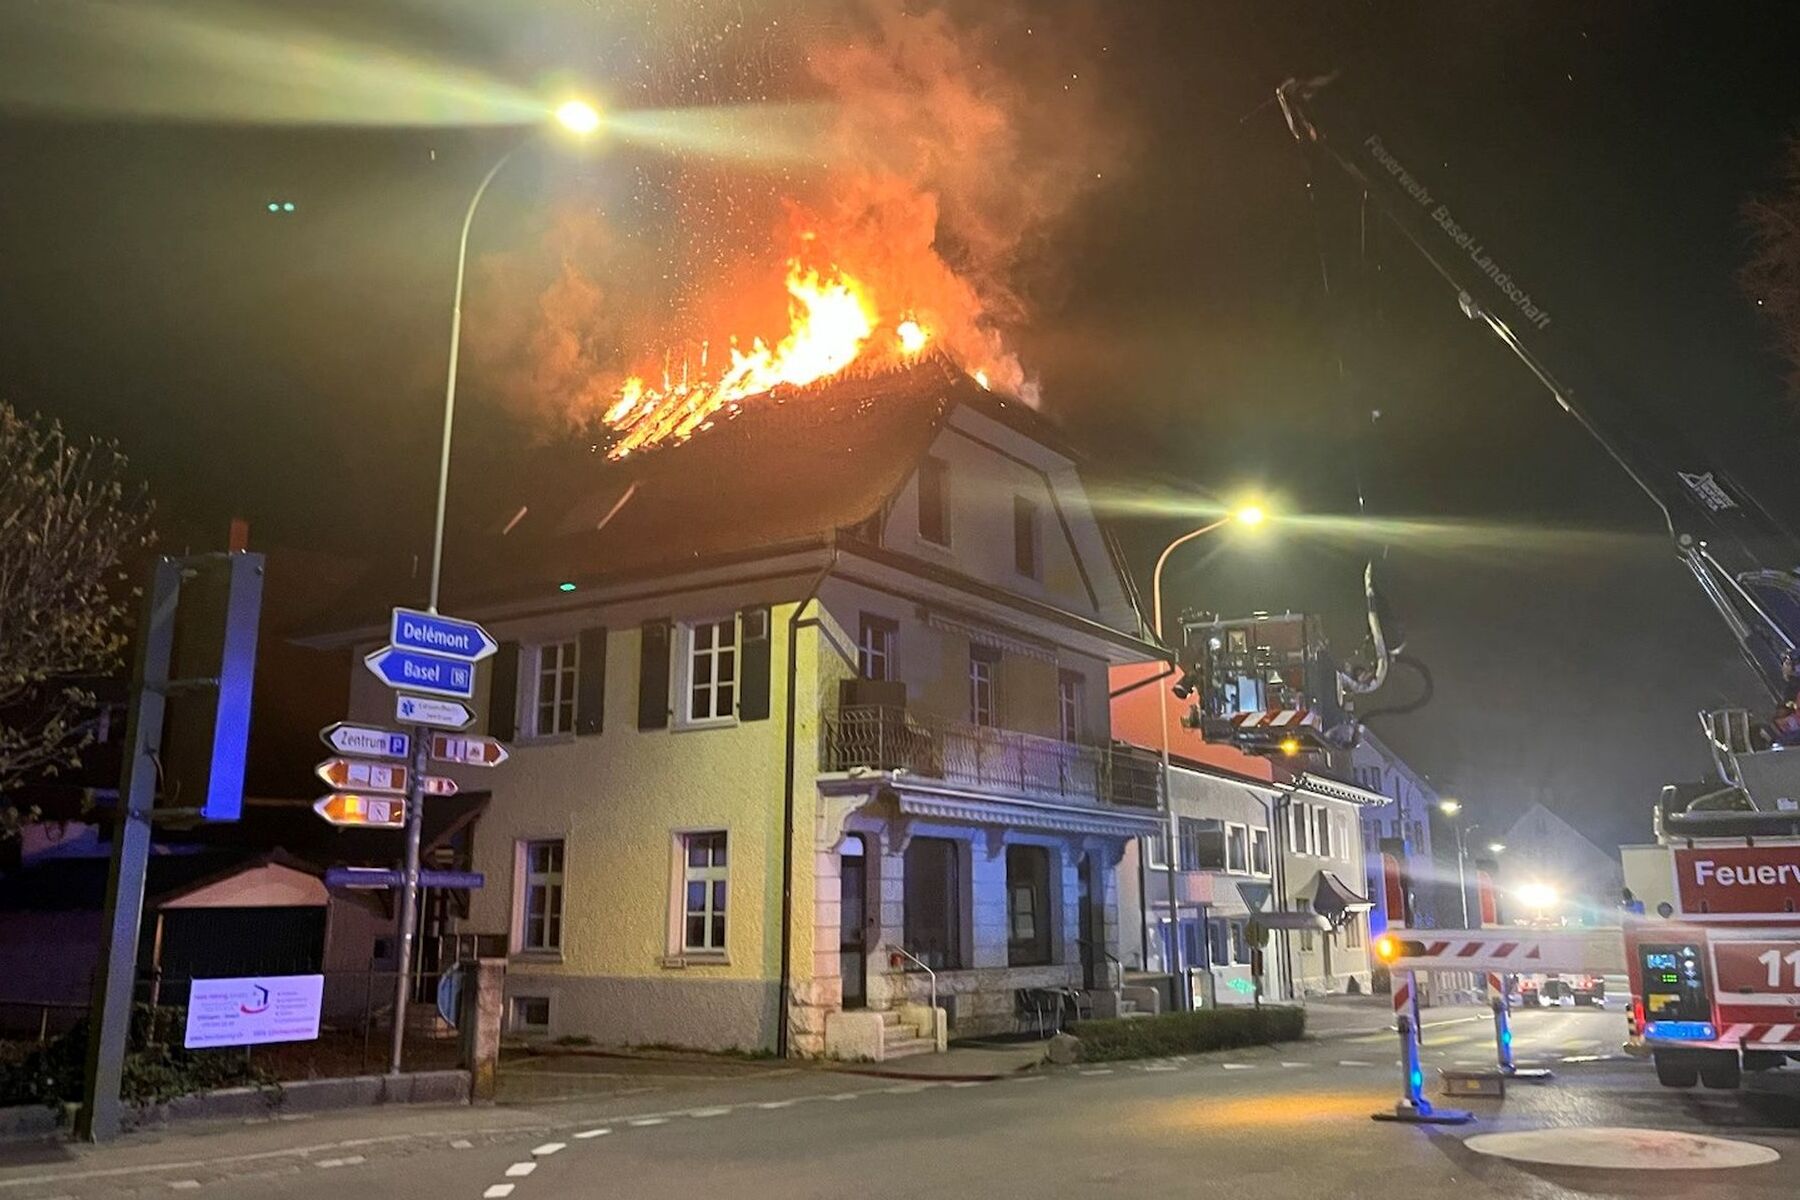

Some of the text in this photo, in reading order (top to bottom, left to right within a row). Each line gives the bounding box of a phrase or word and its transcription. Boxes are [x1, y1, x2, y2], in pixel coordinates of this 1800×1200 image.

[1365, 134, 1551, 329] Feuerwehr Basel-Landschaft
[403, 622, 470, 648] Delémont
[404, 660, 440, 682] Basel
[340, 730, 387, 750] Zentrum
